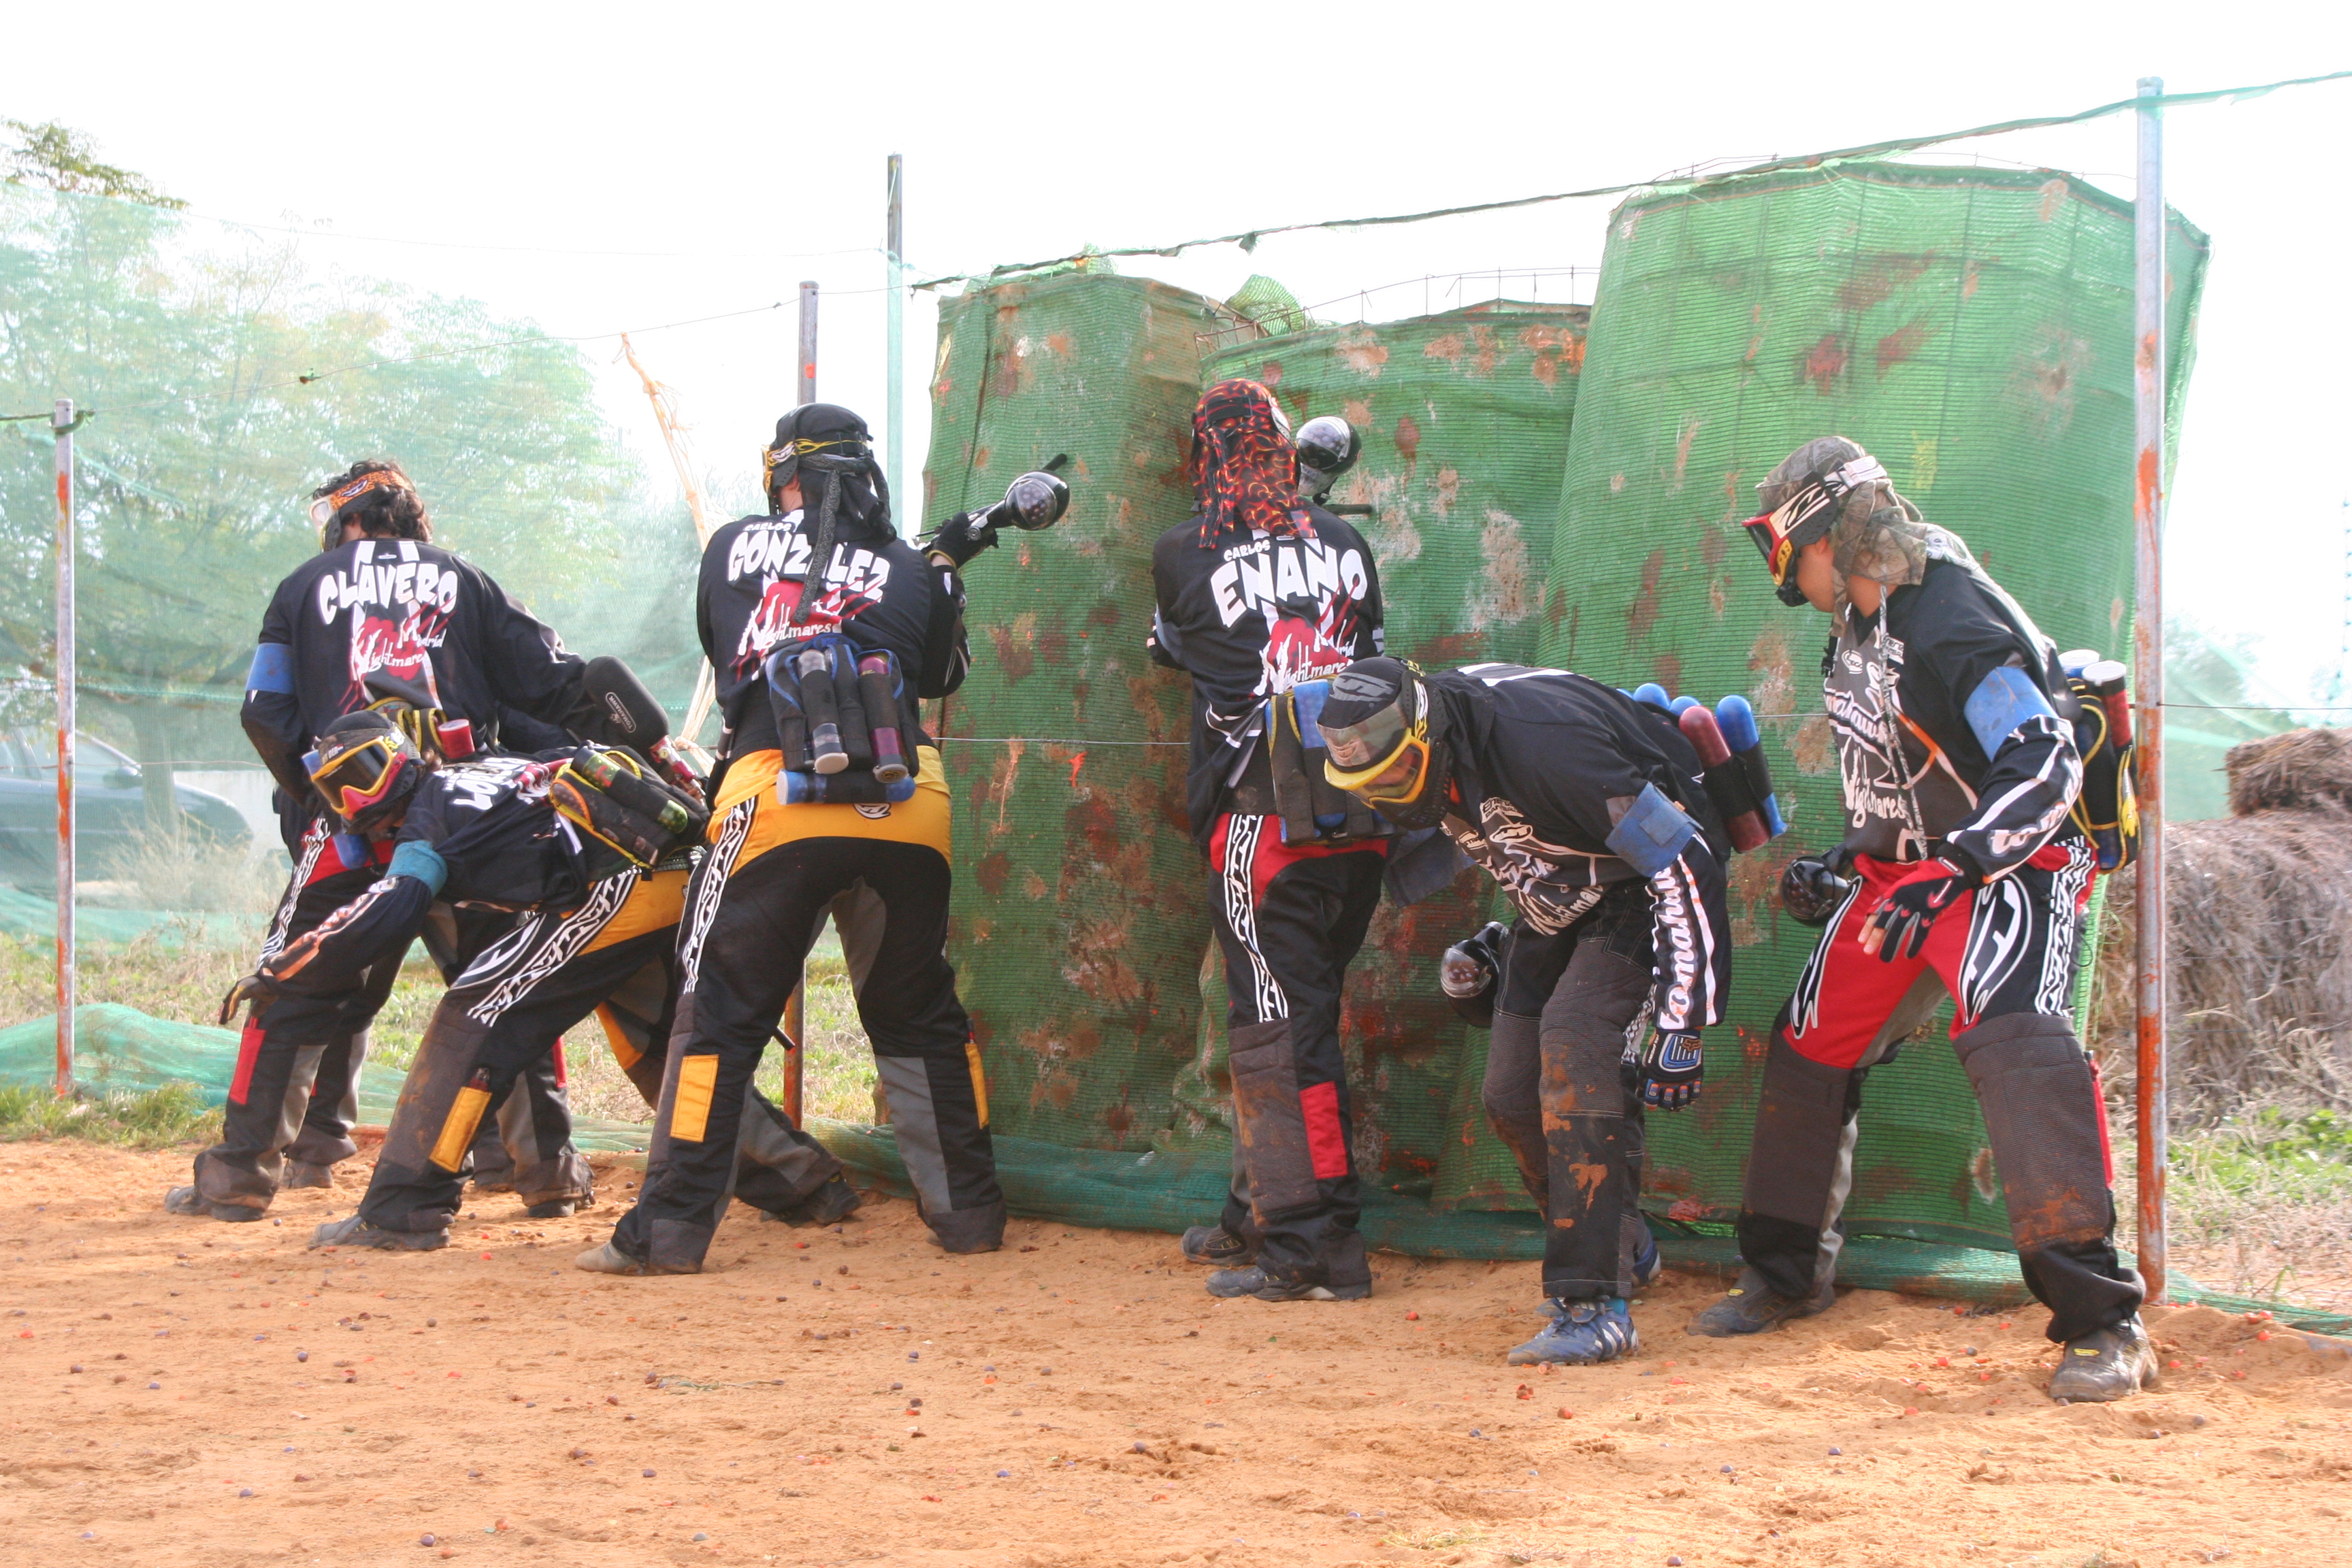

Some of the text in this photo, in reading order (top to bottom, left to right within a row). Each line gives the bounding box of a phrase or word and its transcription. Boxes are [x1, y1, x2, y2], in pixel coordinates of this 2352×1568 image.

[743, 522, 792, 532] CARLOS
[1224, 539, 1271, 561] CARLOS
[318, 563, 459, 625] CLAVERO
[728, 529, 891, 604] GONZLEZ
[1210, 544, 1368, 628] ENANO
[351, 627, 423, 682] Nightmare
[608, 695, 633, 730] TOMAHAWK
[1659, 866, 1696, 1030] tomahaw
